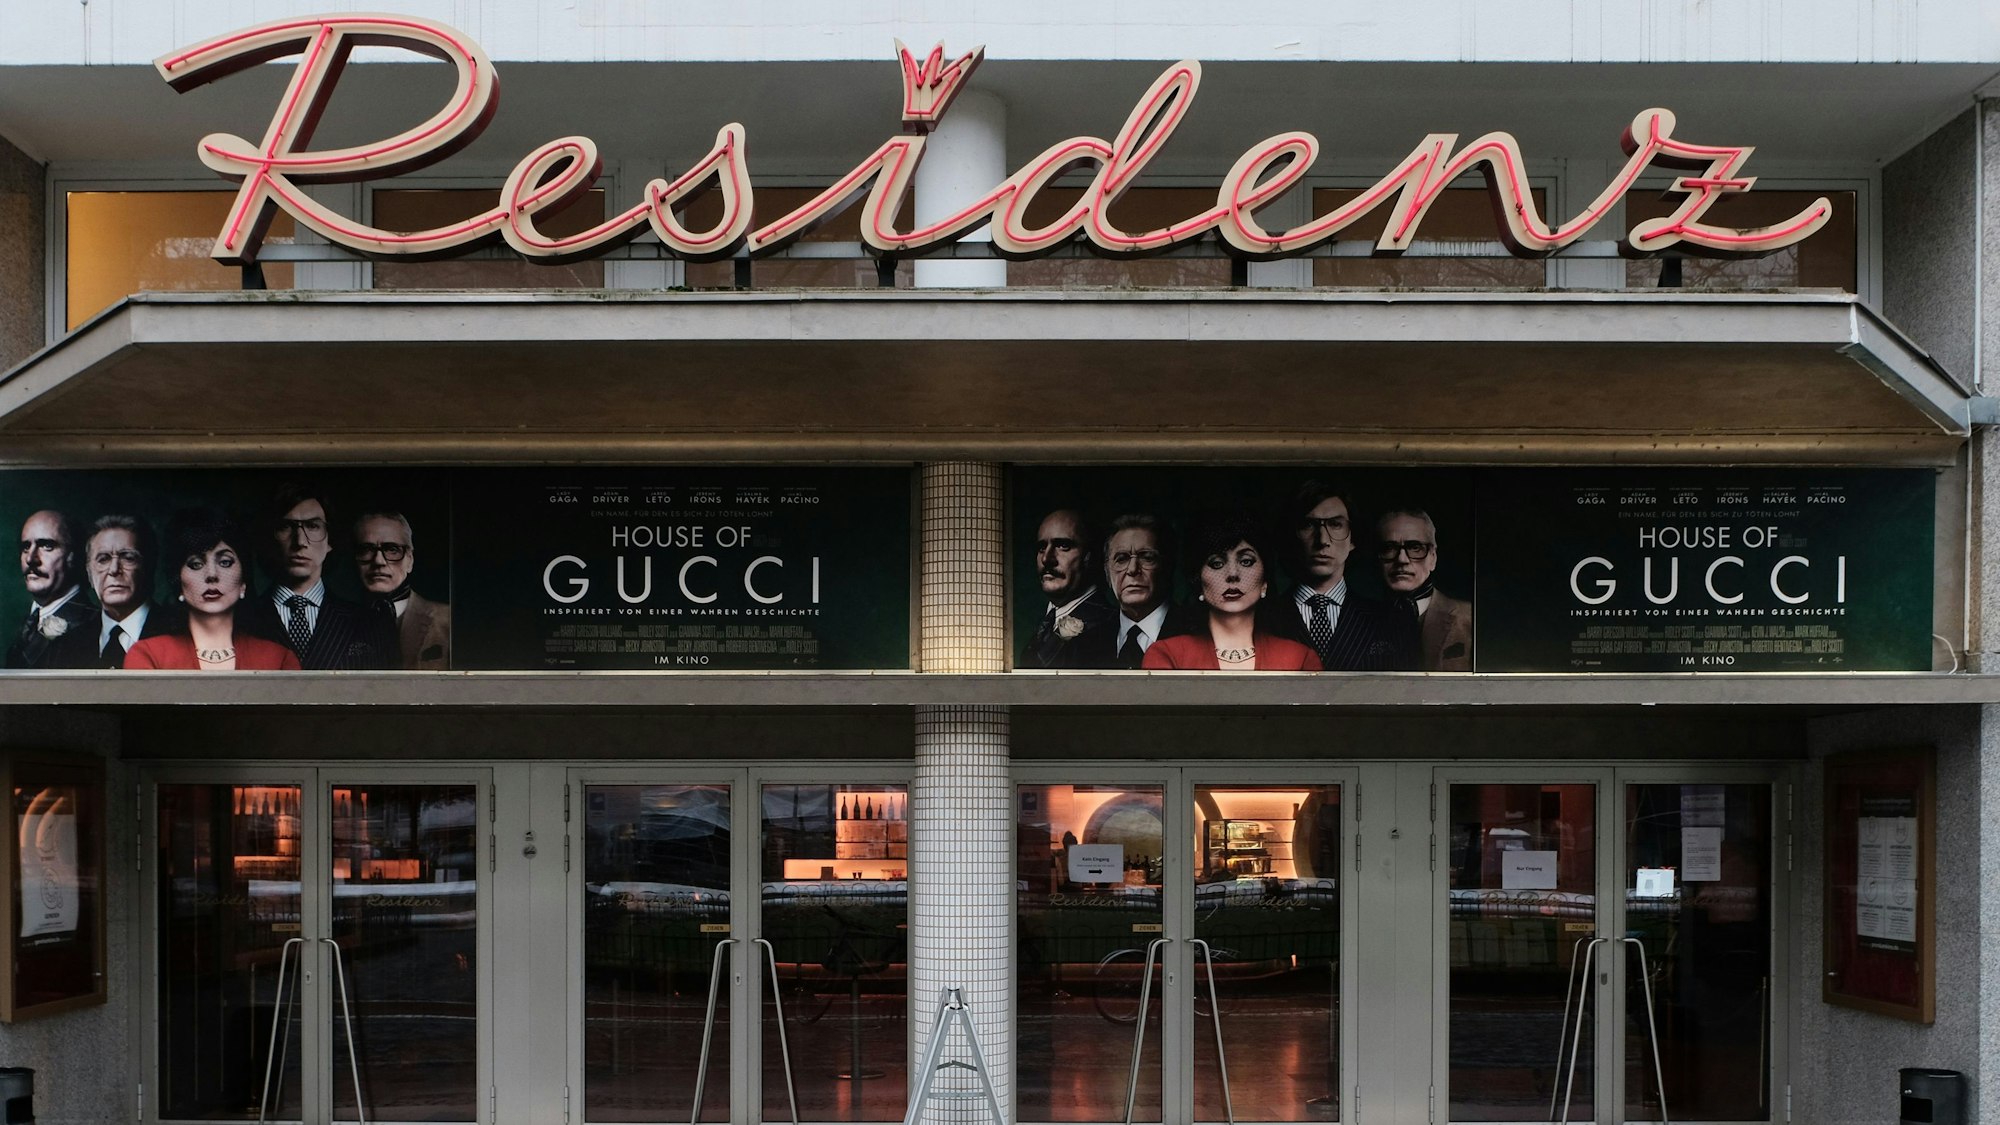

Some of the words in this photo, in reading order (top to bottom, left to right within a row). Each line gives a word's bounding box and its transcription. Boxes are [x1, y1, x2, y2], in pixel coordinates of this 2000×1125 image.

[153, 12, 1832, 262] Residenz
[549, 496, 578, 504] GAGA
[593, 496, 630, 504] DRIVER
[646, 496, 671, 504] LETO
[690, 496, 722, 504] IRONS
[736, 496, 770, 504] HAYEK
[780, 496, 820, 504] PACINO
[612, 526, 703, 548] HOUSE
[716, 526, 752, 548] OF
[1640, 526, 1731, 549] HOUSE
[1743, 526, 1778, 548] OF
[543, 555, 820, 604] GUCCI
[1570, 556, 1846, 605] GUCCI
[544, 608, 612, 616] INSPIRIERT
[618, 608, 643, 616] VON
[650, 608, 684, 616] EINER
[690, 608, 739, 616] WAHREN
[746, 608, 820, 616] GESCHICHTE
[655, 656, 669, 665] IM
[677, 656, 710, 665] KINO
[1680, 656, 1696, 665] IM
[1702, 656, 1735, 665] KINO
[366, 893, 444, 907] Residenz
[1048, 893, 1127, 908] Residenz
